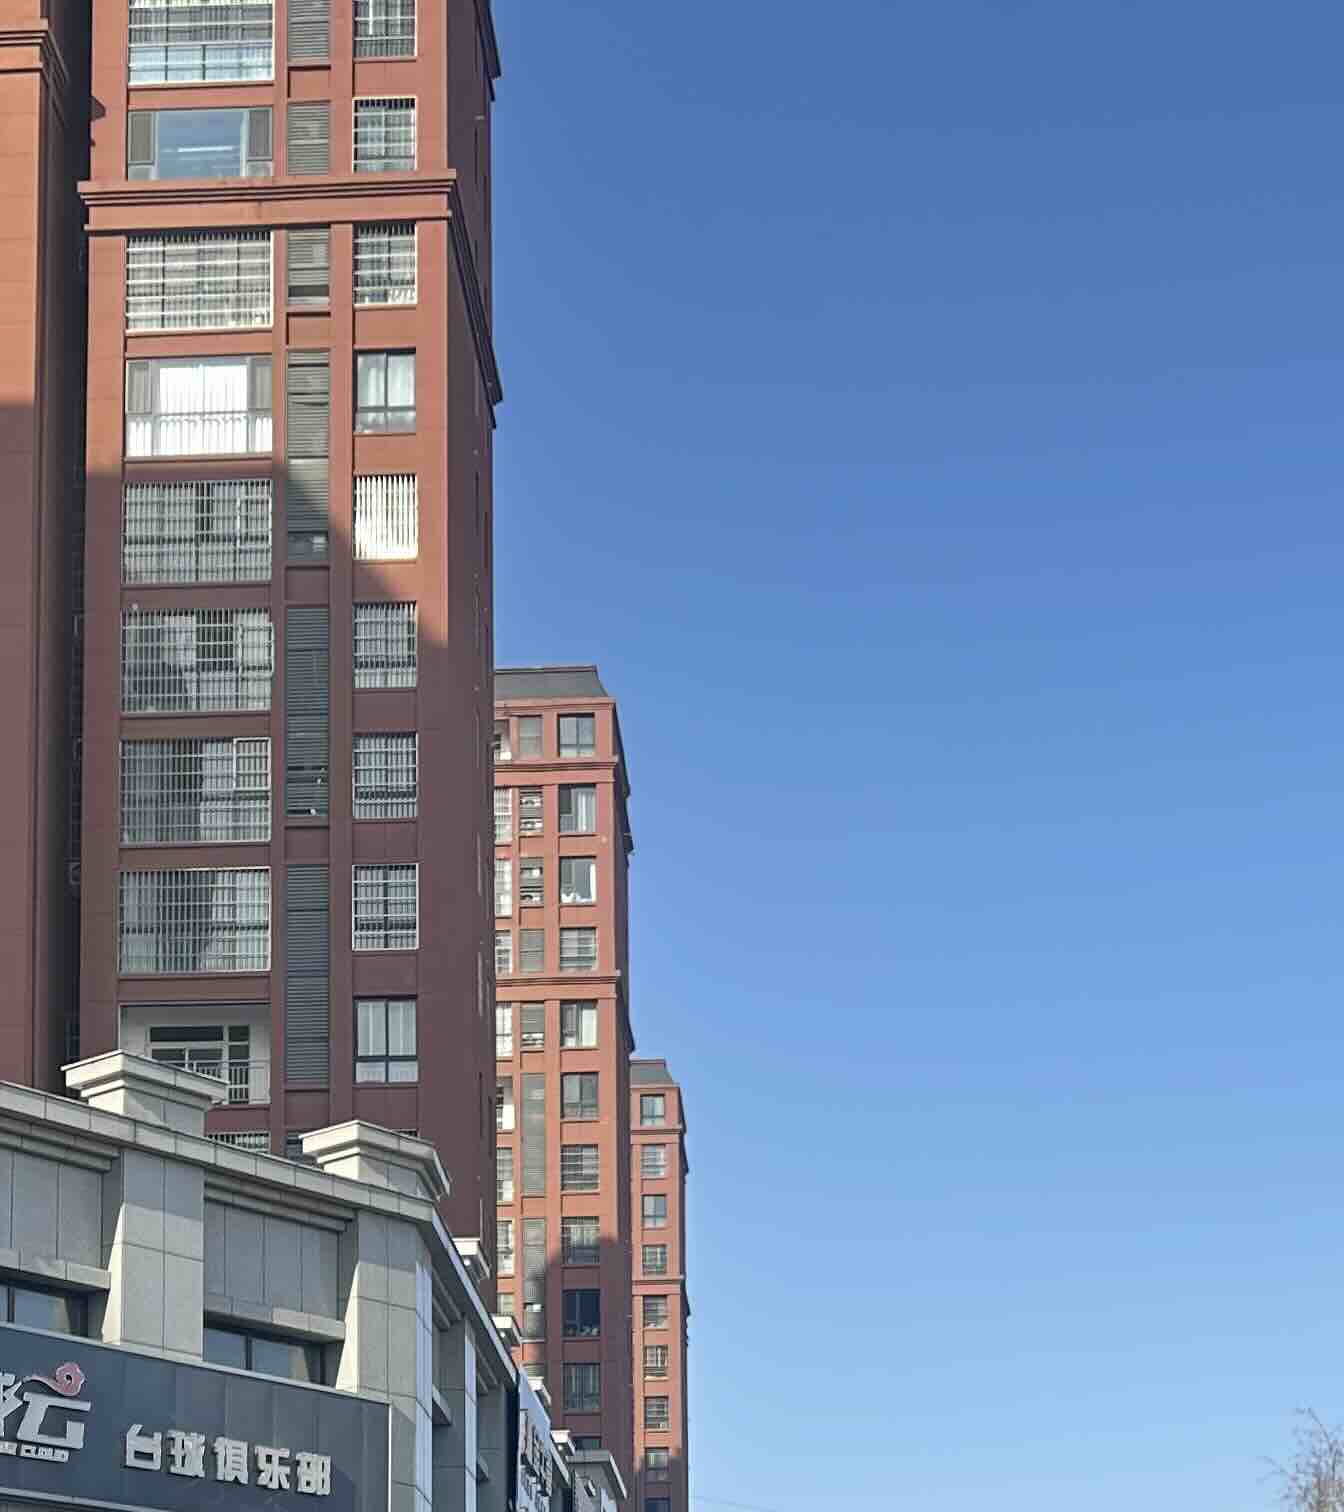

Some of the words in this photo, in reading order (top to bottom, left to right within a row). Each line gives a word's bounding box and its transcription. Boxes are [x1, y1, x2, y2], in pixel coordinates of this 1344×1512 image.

[125, 1424, 332, 1497] 台球俱乐部
